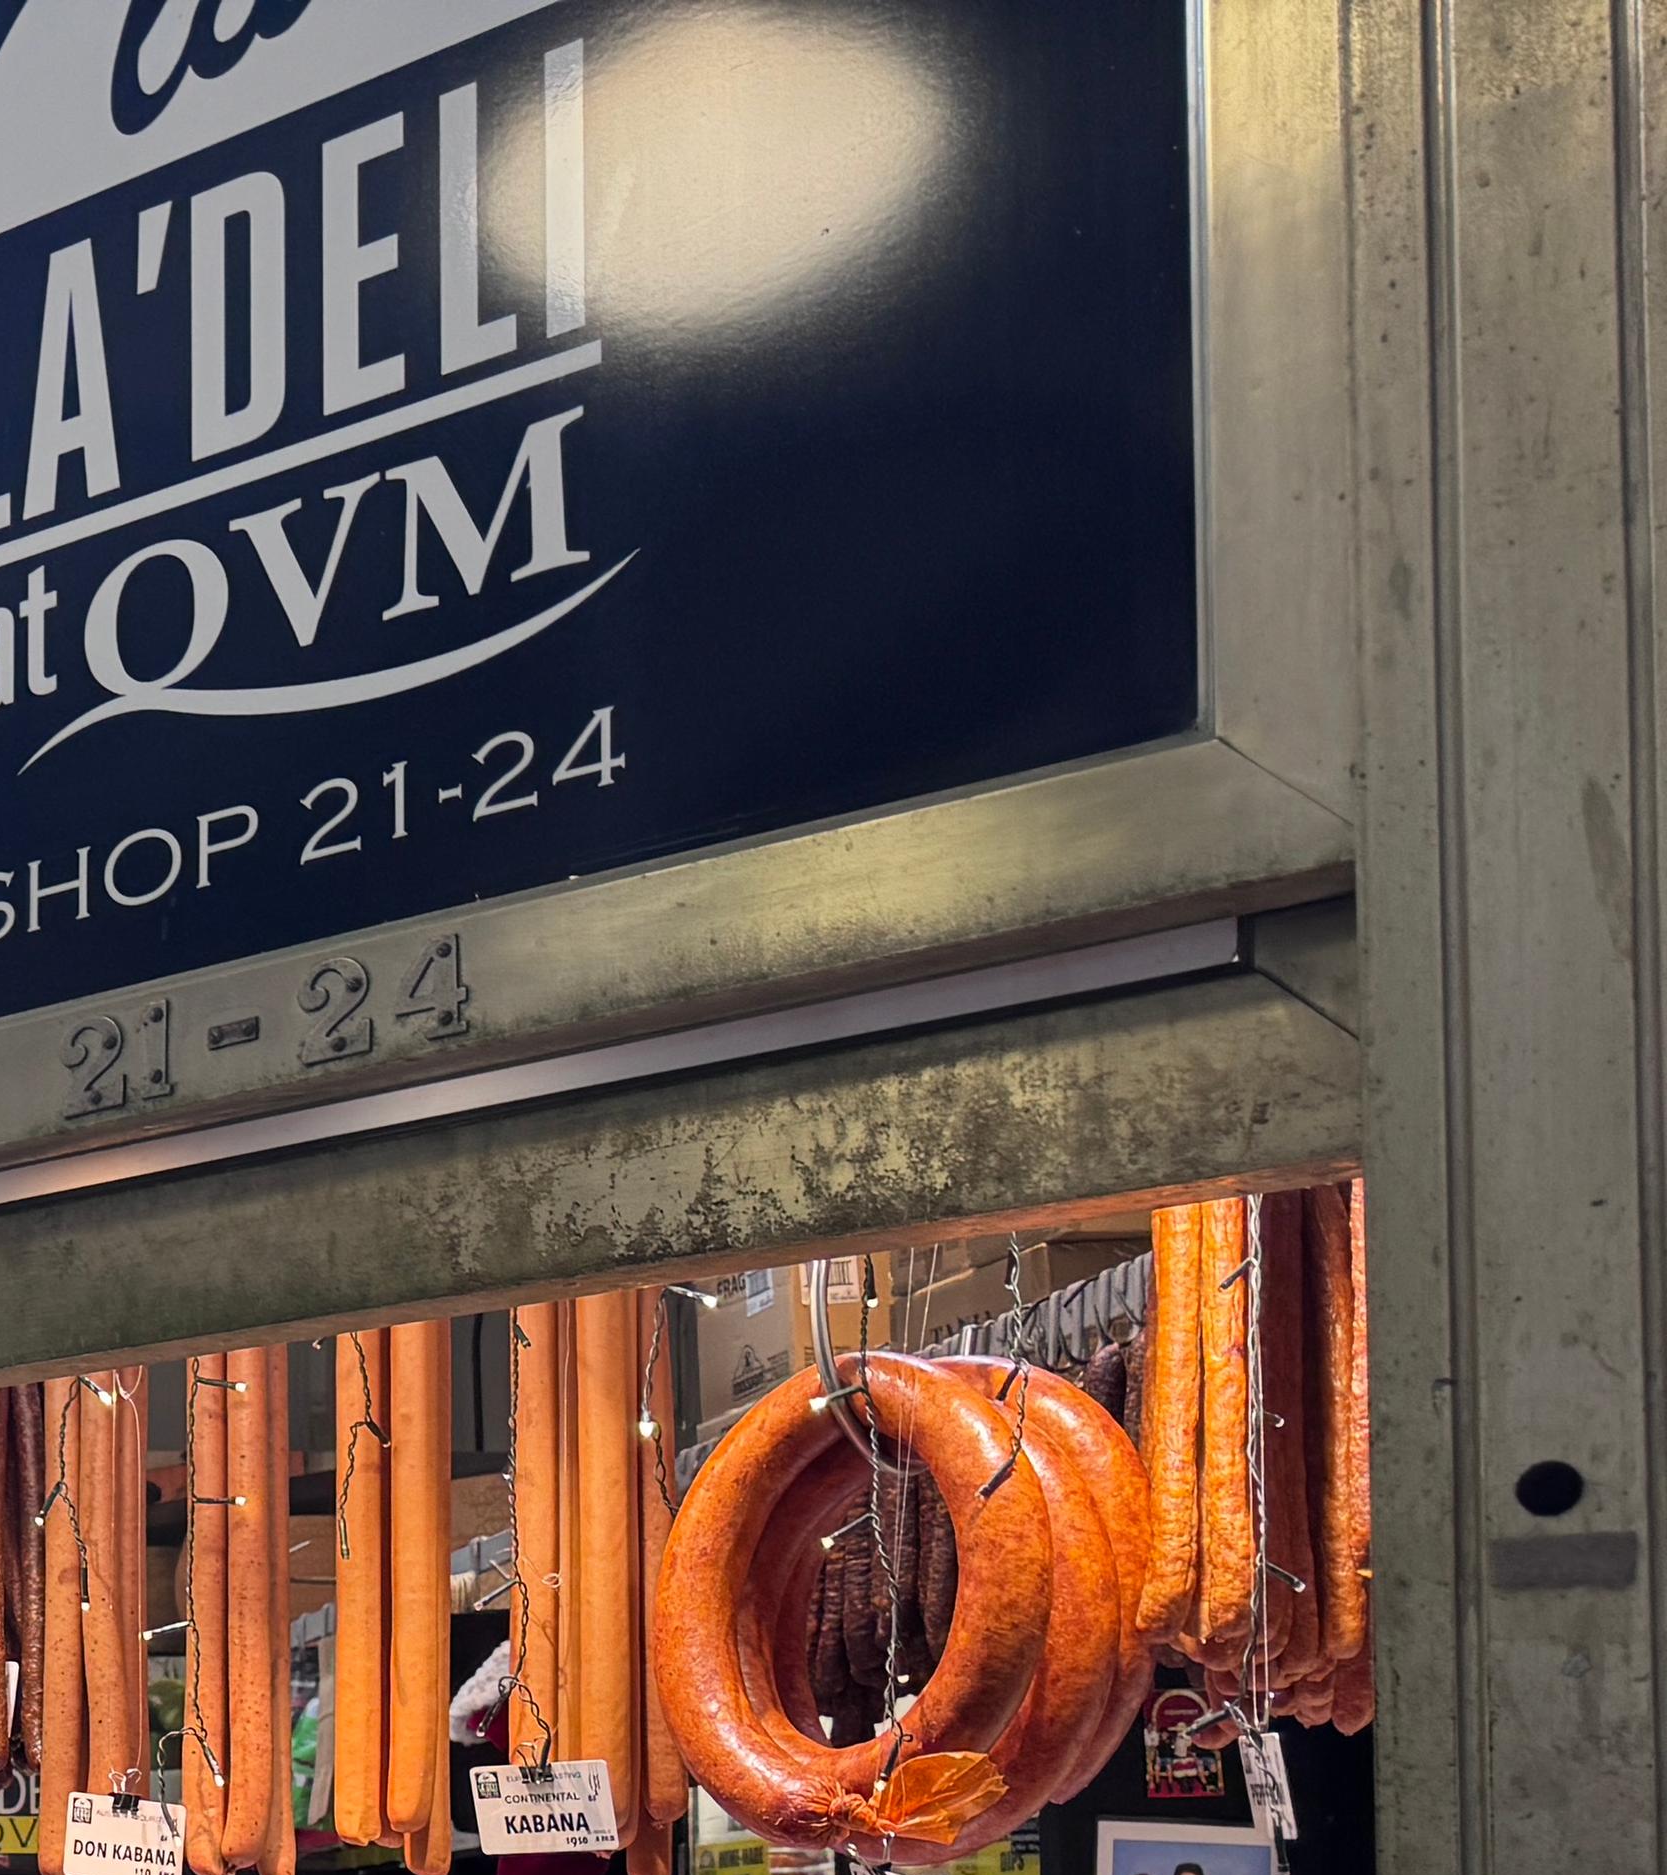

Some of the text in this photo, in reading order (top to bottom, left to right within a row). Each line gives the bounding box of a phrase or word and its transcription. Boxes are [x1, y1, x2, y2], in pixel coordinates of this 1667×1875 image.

[52, 405, 612, 730] QVM
[298, 704, 627, 867] 21-24
[504, 1791, 581, 1805] CONTINENTAL
[504, 1811, 591, 1835] KABANA
[73, 1838, 177, 1868] DON KABANA
